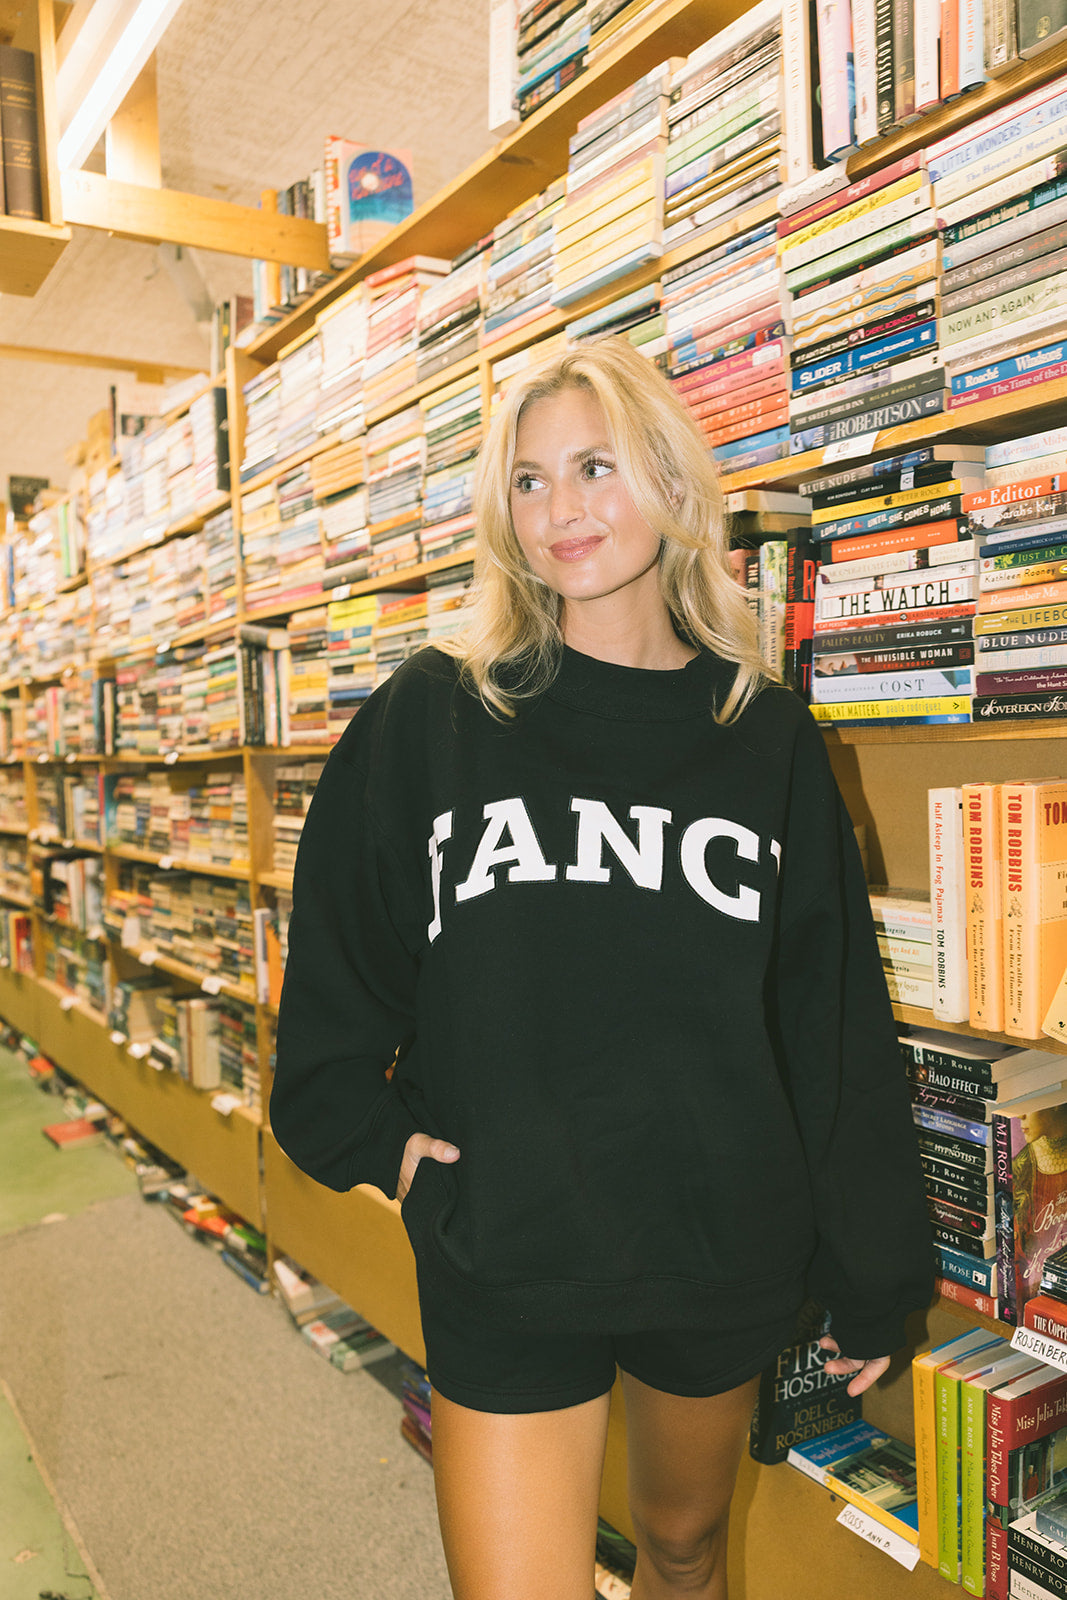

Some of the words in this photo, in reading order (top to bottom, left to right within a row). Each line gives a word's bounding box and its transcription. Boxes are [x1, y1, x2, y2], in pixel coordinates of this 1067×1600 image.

[875, 39, 891, 94] ROSSNER
[941, 147, 972, 173] LITTLE
[975, 122, 1022, 156] WONDERS
[944, 268, 970, 287] what
[972, 260, 994, 275] was
[995, 246, 1024, 265] mine
[947, 291, 973, 307] what
[974, 282, 996, 297] was
[997, 270, 1028, 288] mine
[884, 311, 917, 328] ROBINSON
[948, 320, 972, 335] NOW
[975, 308, 997, 324] AND
[1000, 294, 1036, 314] AGAIN
[799, 361, 842, 385] SLIDER
[859, 346, 881, 362] PATRICK
[881, 337, 915, 352] ROBINSON
[1014, 347, 1064, 372] Windsong
[991, 382, 1009, 396] The
[1009, 375, 1032, 391] Time
[1033, 368, 1047, 384] of
[1046, 367, 1060, 380] the
[795, 416, 807, 427] THE
[807, 409, 830, 423] SWEET
[837, 397, 923, 438] ROBERTSON
[1002, 442, 1040, 457] German
[799, 479, 826, 497] BLUE
[827, 471, 857, 488] NUDE
[918, 487, 942, 500] ROCK
[972, 496, 988, 505] The
[989, 484, 1042, 506] Editor
[820, 522, 838, 538] LORI
[837, 521, 853, 536] ROY
[867, 513, 888, 528] UNTIL
[888, 510, 904, 525] SHE
[903, 503, 930, 522] COMES
[930, 500, 952, 518] HOME
[999, 504, 1033, 520] Sarah's
[1036, 500, 1057, 515] Key
[838, 542, 878, 554] SABBATH'S
[880, 535, 916, 547] THEATER
[787, 546, 796, 575] Thomas
[1017, 552, 1040, 564] JUST
[1045, 549, 1057, 559] IN
[984, 570, 1021, 584] Kathleen
[1023, 565, 1056, 579] Rooney
[838, 593, 872, 618] THE
[880, 580, 950, 613] WATCH
[990, 591, 1042, 605] Remember
[1042, 586, 1060, 598] Me
[785, 605, 794, 621] RED
[818, 622, 828, 630] CAT
[828, 620, 848, 629] PERSON
[877, 614, 898, 623] STORIES
[912, 610, 935, 619] KRISTEN
[935, 606, 970, 617] ROUPENIAN
[785, 622, 794, 649] DEUCE
[821, 636, 850, 649] FALLEN
[852, 633, 886, 647] BEAUTY
[896, 631, 915, 640] ERIKA
[916, 628, 943, 638] ROBUCK
[982, 635, 1019, 649] BLUE
[769, 636, 777, 664] WATER
[861, 656, 871, 664] THE
[873, 650, 916, 664] INVISIBLE
[919, 647, 954, 660] WOMAN
[883, 661, 904, 670] ERIKA
[906, 658, 936, 668] ROBUCK
[879, 677, 926, 694] COST
[1036, 681, 1046, 689] the
[1046, 679, 1061, 689] Hunt
[817, 705, 845, 720] URGENT
[847, 703, 881, 717] MATTERS
[885, 703, 906, 715] paula
[906, 701, 942, 715] rodriguez
[980, 699, 1041, 717] SOVEREIGN
[934, 802, 943, 820] Half
[969, 793, 982, 822] TOM
[1008, 794, 1023, 824] TOM
[934, 822, 944, 851] Asleep
[936, 853, 944, 863] In
[969, 827, 984, 889] ROBBINS
[1008, 828, 1023, 893] ROBBINS
[934, 865, 945, 885] Frog
[935, 887, 945, 923] Pajamas
[936, 929, 945, 948] TOM
[936, 950, 946, 989] ROBBINS
[926, 1053, 948, 1066] M.J.
[950, 1059, 973, 1073] Rose
[928, 1070, 950, 1088] HALO
[951, 1077, 980, 1095] EFFECT
[995, 1122, 1007, 1147] M.J.
[934, 1143, 978, 1164] HYPNOTIST
[944, 1167, 965, 1182] Rose
[996, 1150, 1008, 1185] ROSE
[947, 1188, 968, 1203] Rose
[935, 1228, 961, 1245] ROSE
[948, 1260, 972, 1279] ROSE
[1033, 1313, 1048, 1331] THE
[1016, 1330, 1067, 1366] ROSENBER
[794, 1402, 825, 1428] JOEL
[990, 1404, 1001, 1426] Miss
[1016, 1414, 1036, 1433] Miss
[1035, 1402, 1054, 1433] Julia
[775, 1409, 855, 1450] ROSENBERG
[966, 1426, 974, 1449] ROSS
[989, 1426, 1004, 1448] Julia
[990, 1449, 1002, 1474] Takes
[990, 1475, 1000, 1499] Over
[842, 1509, 865, 1534] ROSS,
[866, 1530, 882, 1544] ANN
[990, 1528, 1001, 1548] Ann
[1013, 1532, 1048, 1558] HENRY
[991, 1549, 1002, 1561] B.
[1011, 1553, 1046, 1579] HENRY
[990, 1561, 1001, 1583] Ross
